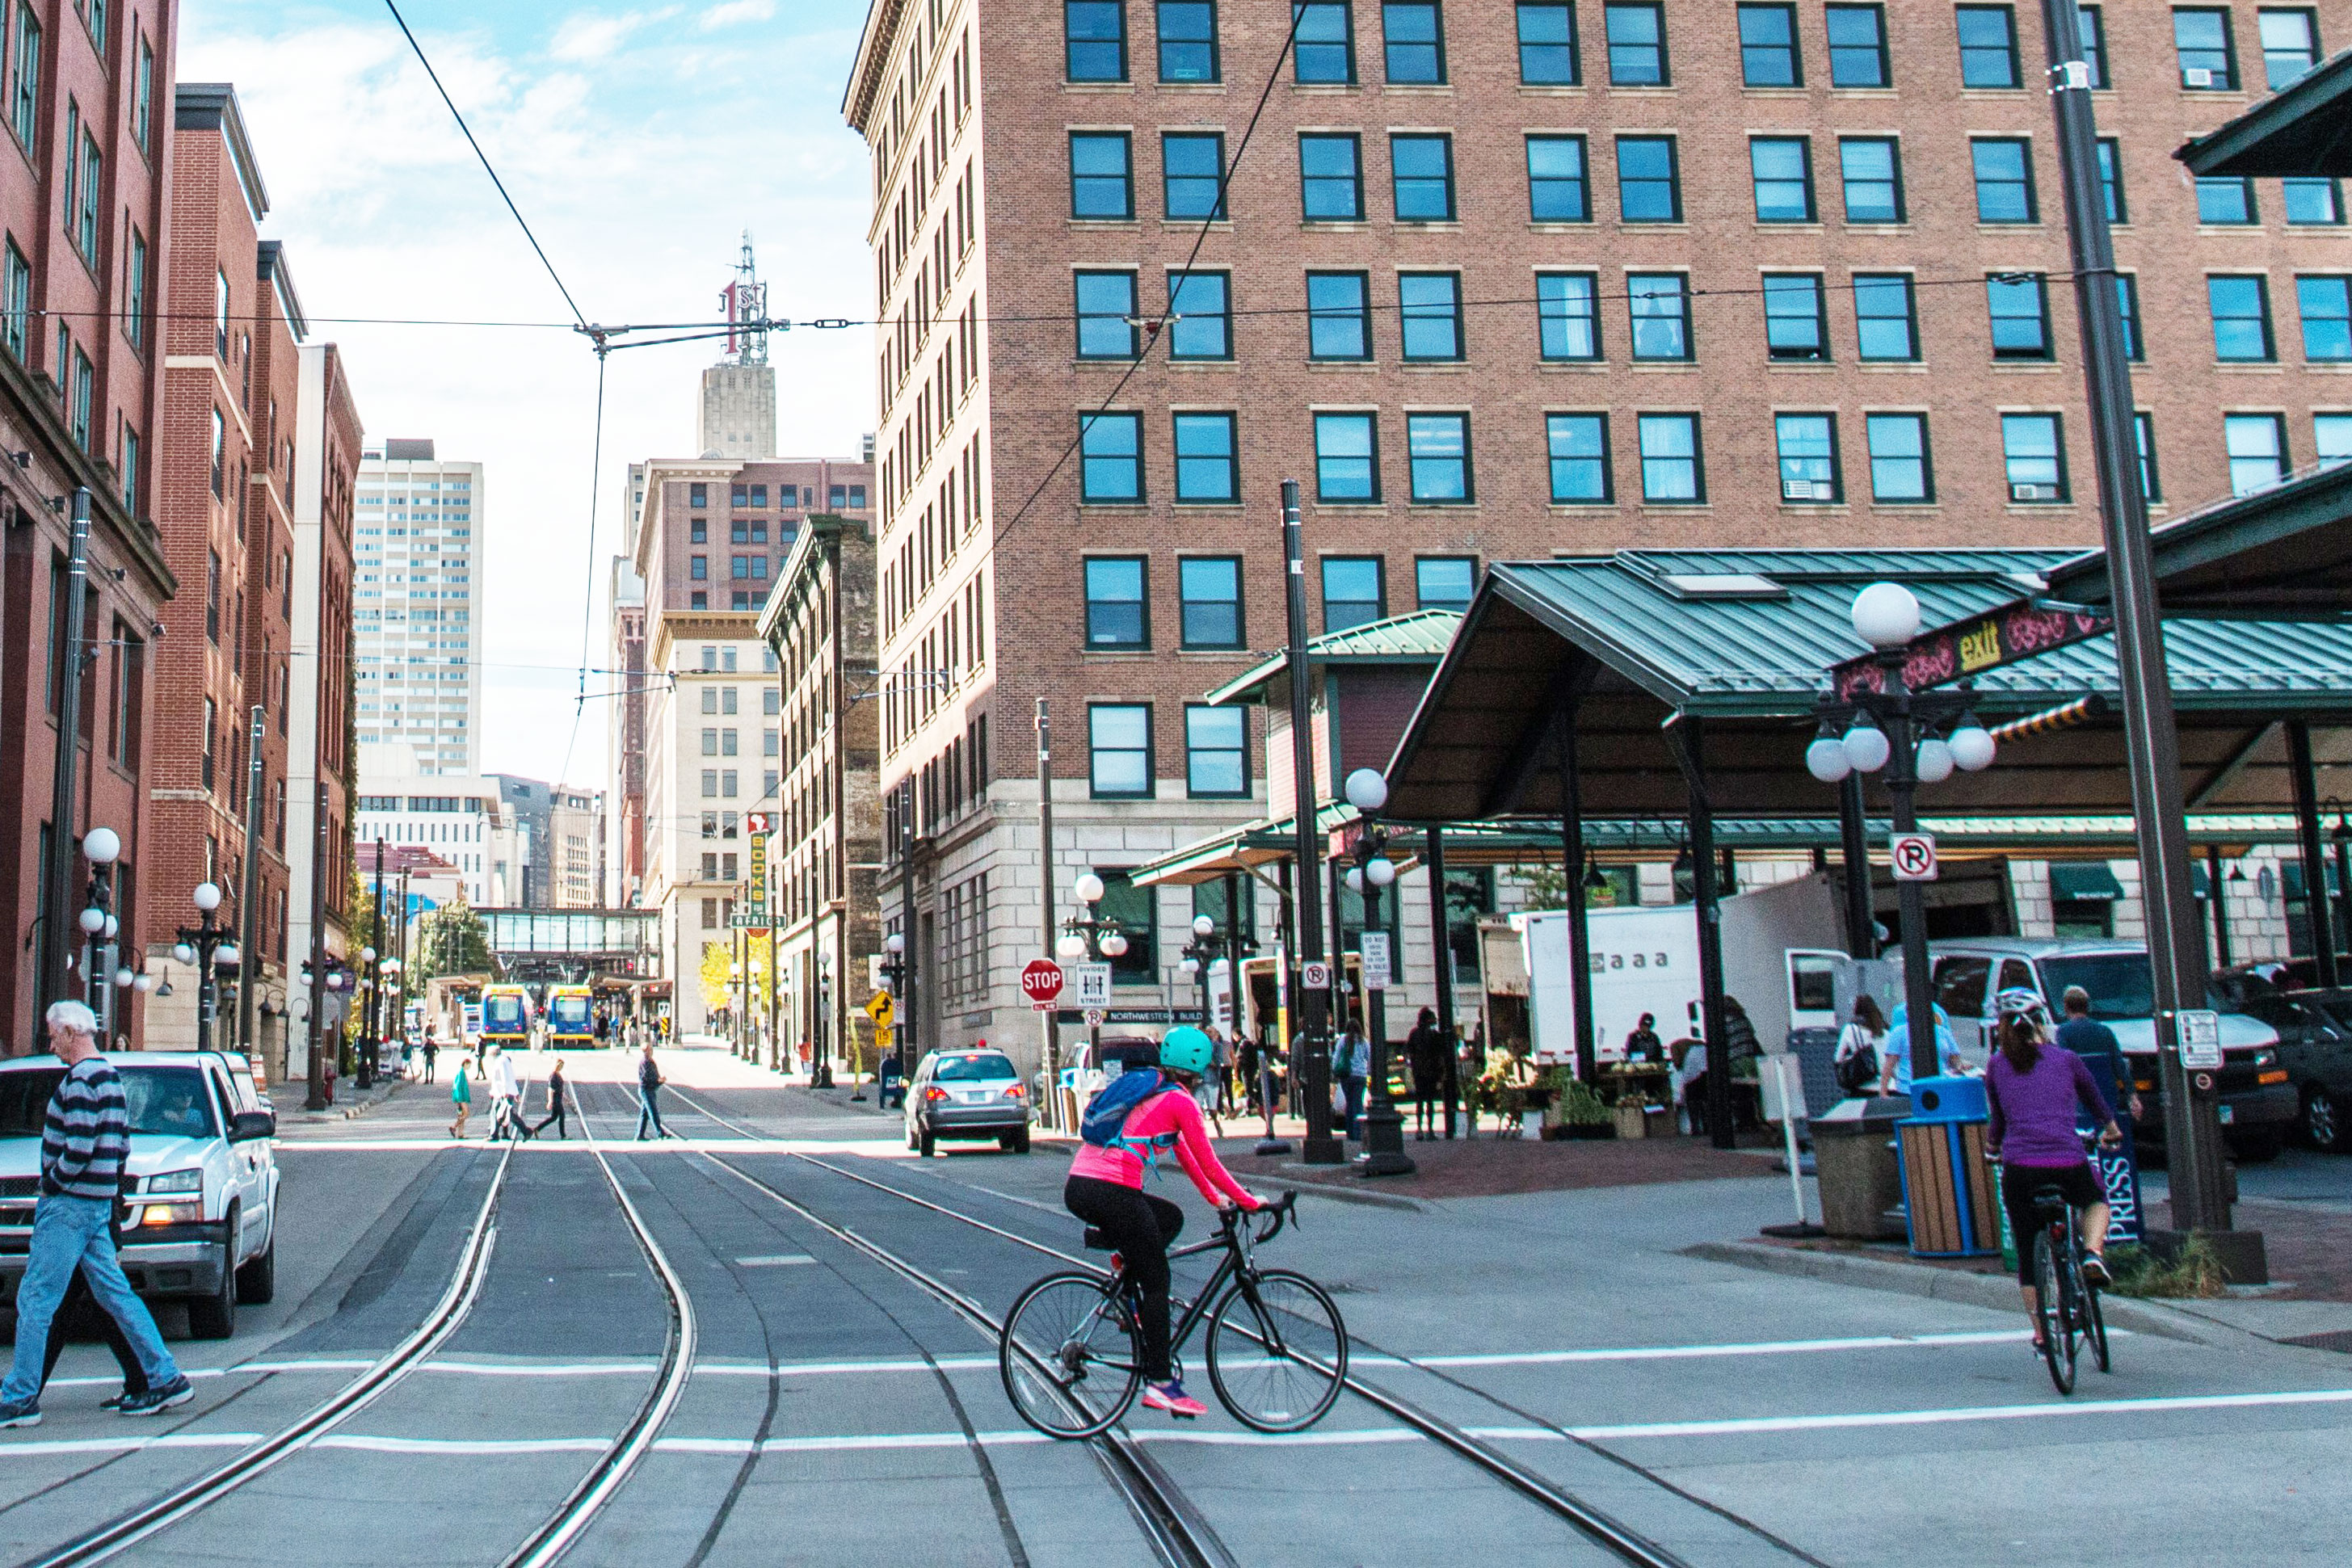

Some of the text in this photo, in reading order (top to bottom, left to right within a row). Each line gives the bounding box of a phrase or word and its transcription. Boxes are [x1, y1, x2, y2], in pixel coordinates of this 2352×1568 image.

[1959, 620, 2000, 664] exit
[752, 836, 766, 902] BOOKS
[736, 915, 780, 927] AFRICA
[1024, 971, 1061, 990] STOP
[878, 1030, 890, 1040] 15
[2102, 1157, 2139, 1240] PRESS
